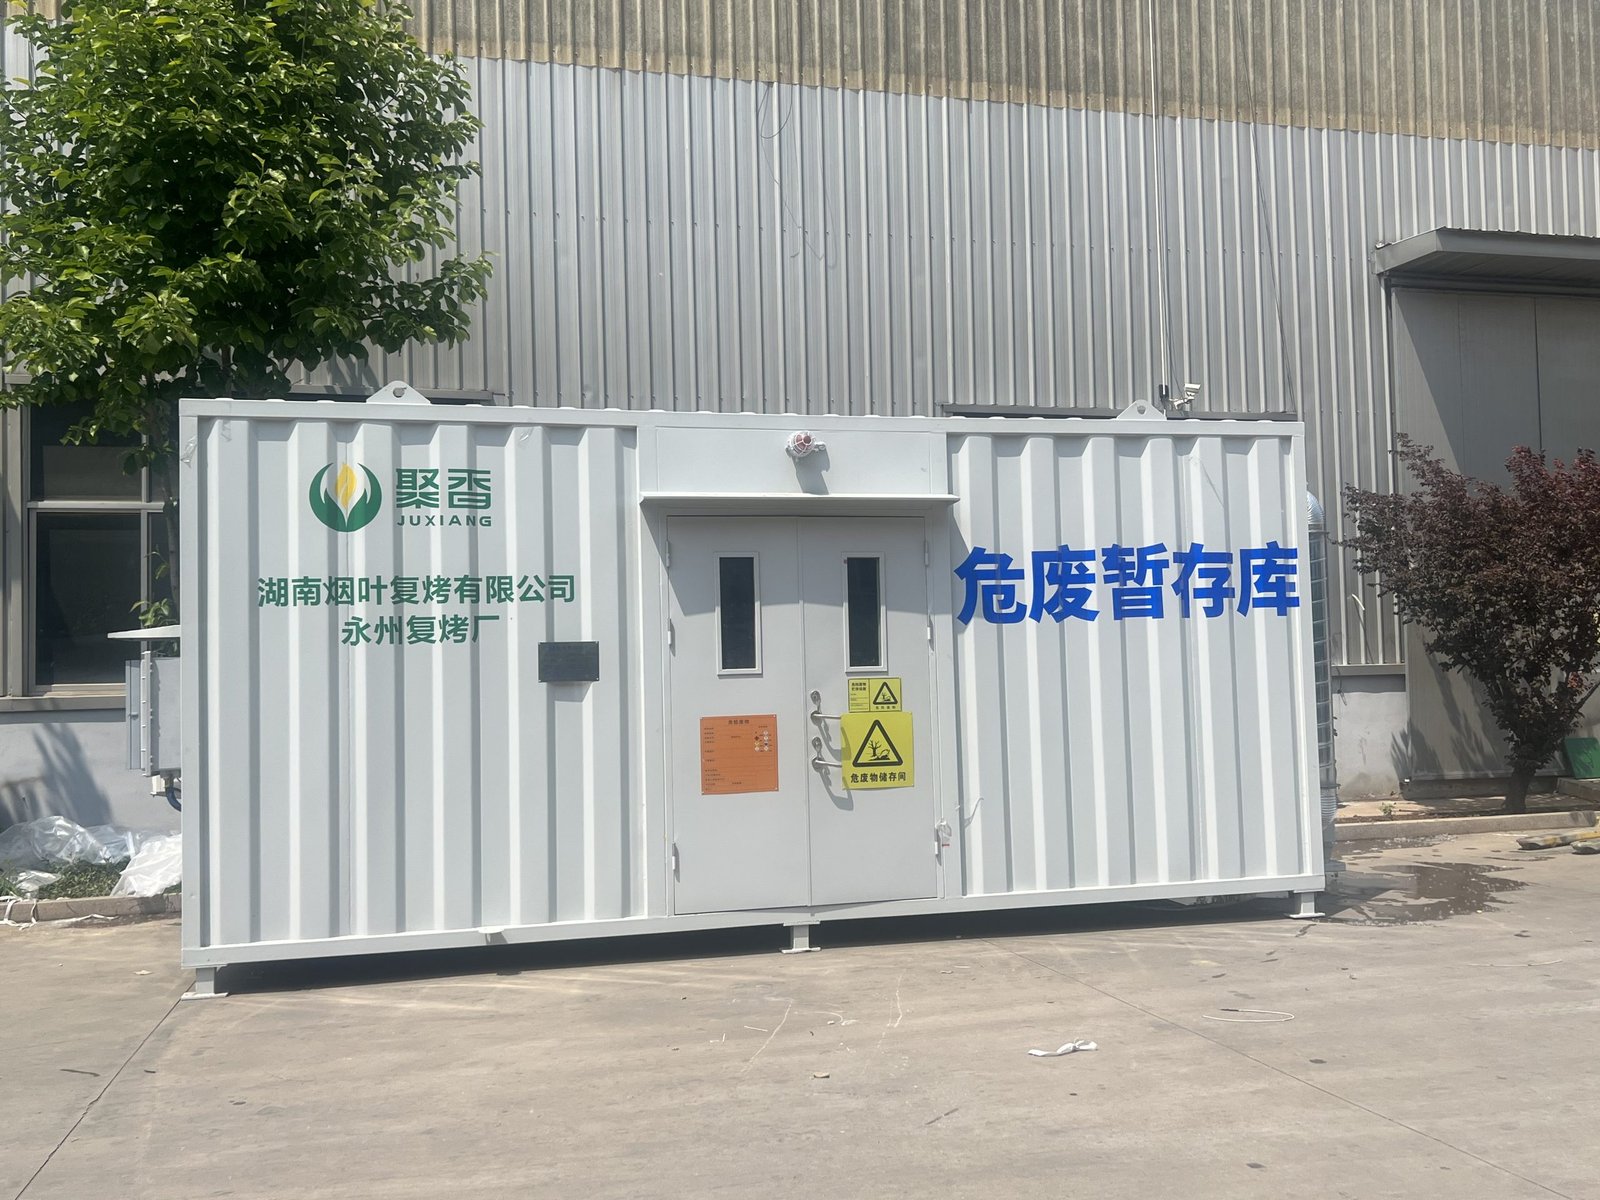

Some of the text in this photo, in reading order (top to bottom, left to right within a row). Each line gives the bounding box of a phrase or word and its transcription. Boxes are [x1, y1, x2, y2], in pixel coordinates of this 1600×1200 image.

[395, 468, 492, 510] 聚香
[396, 514, 492, 528] JUXIANG
[257, 574, 576, 608] 湖南烟叶复烤有限公司
[953, 540, 1301, 626] 危废暂存库
[341, 614, 500, 647] 永州复烤厂
[850, 771, 907, 784] 危废物储存间
